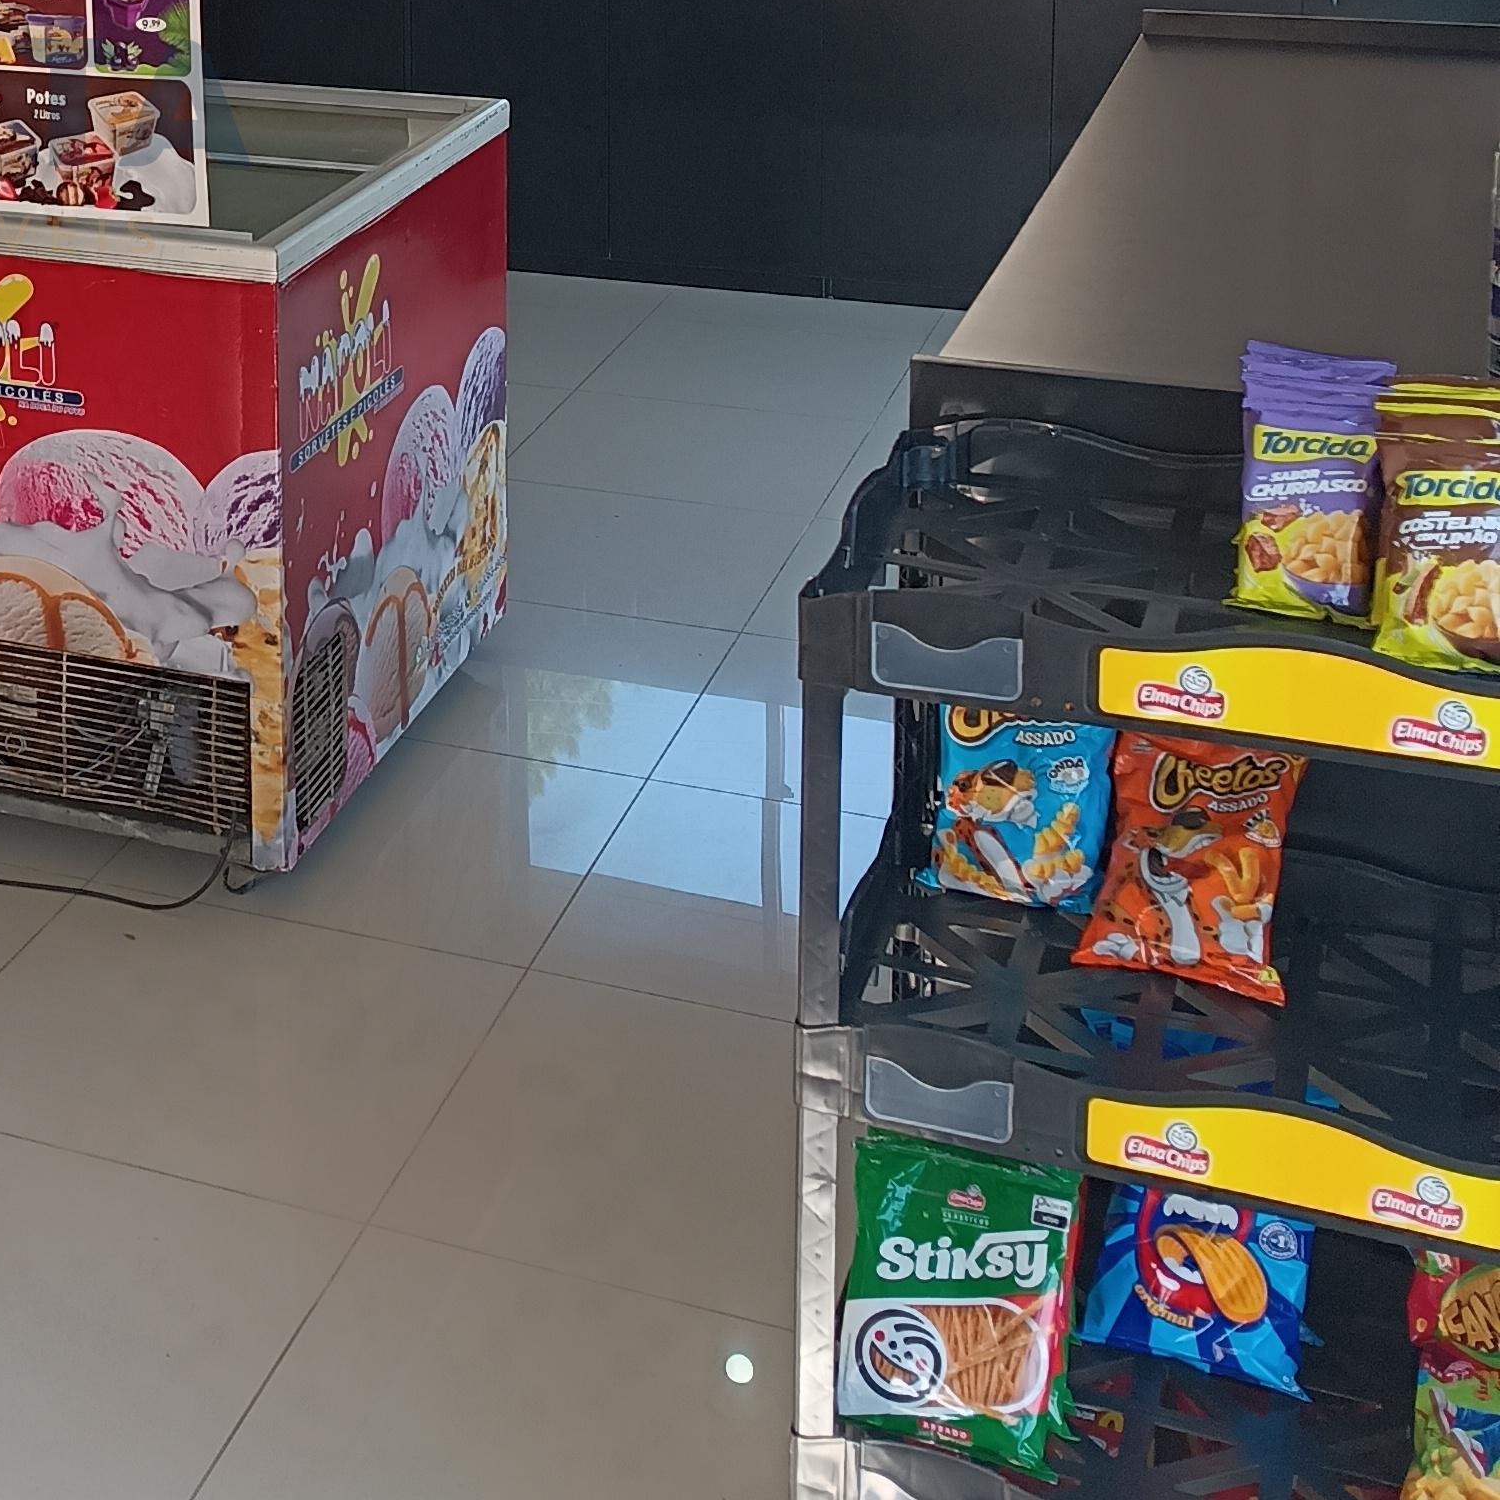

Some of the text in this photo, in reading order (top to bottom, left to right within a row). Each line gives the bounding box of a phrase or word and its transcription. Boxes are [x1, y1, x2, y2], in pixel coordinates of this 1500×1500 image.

[26, 88, 67, 106] Potes
[299, 300, 393, 442] NAPOLI
[298, 415, 348, 465] SORVETES
[1261, 431, 1371, 458] Torcida
[1270, 468, 1320, 483] SABOR
[1252, 479, 1368, 498] CHURRASCO
[1015, 729, 1076, 746] ASSADO
[1049, 757, 1085, 778] ONDA
[1155, 754, 1287, 806] Cheetos
[1207, 793, 1269, 813] ASSADO
[876, 1230, 1050, 1288] Stiksy
[1134, 1284, 1195, 1329] original
